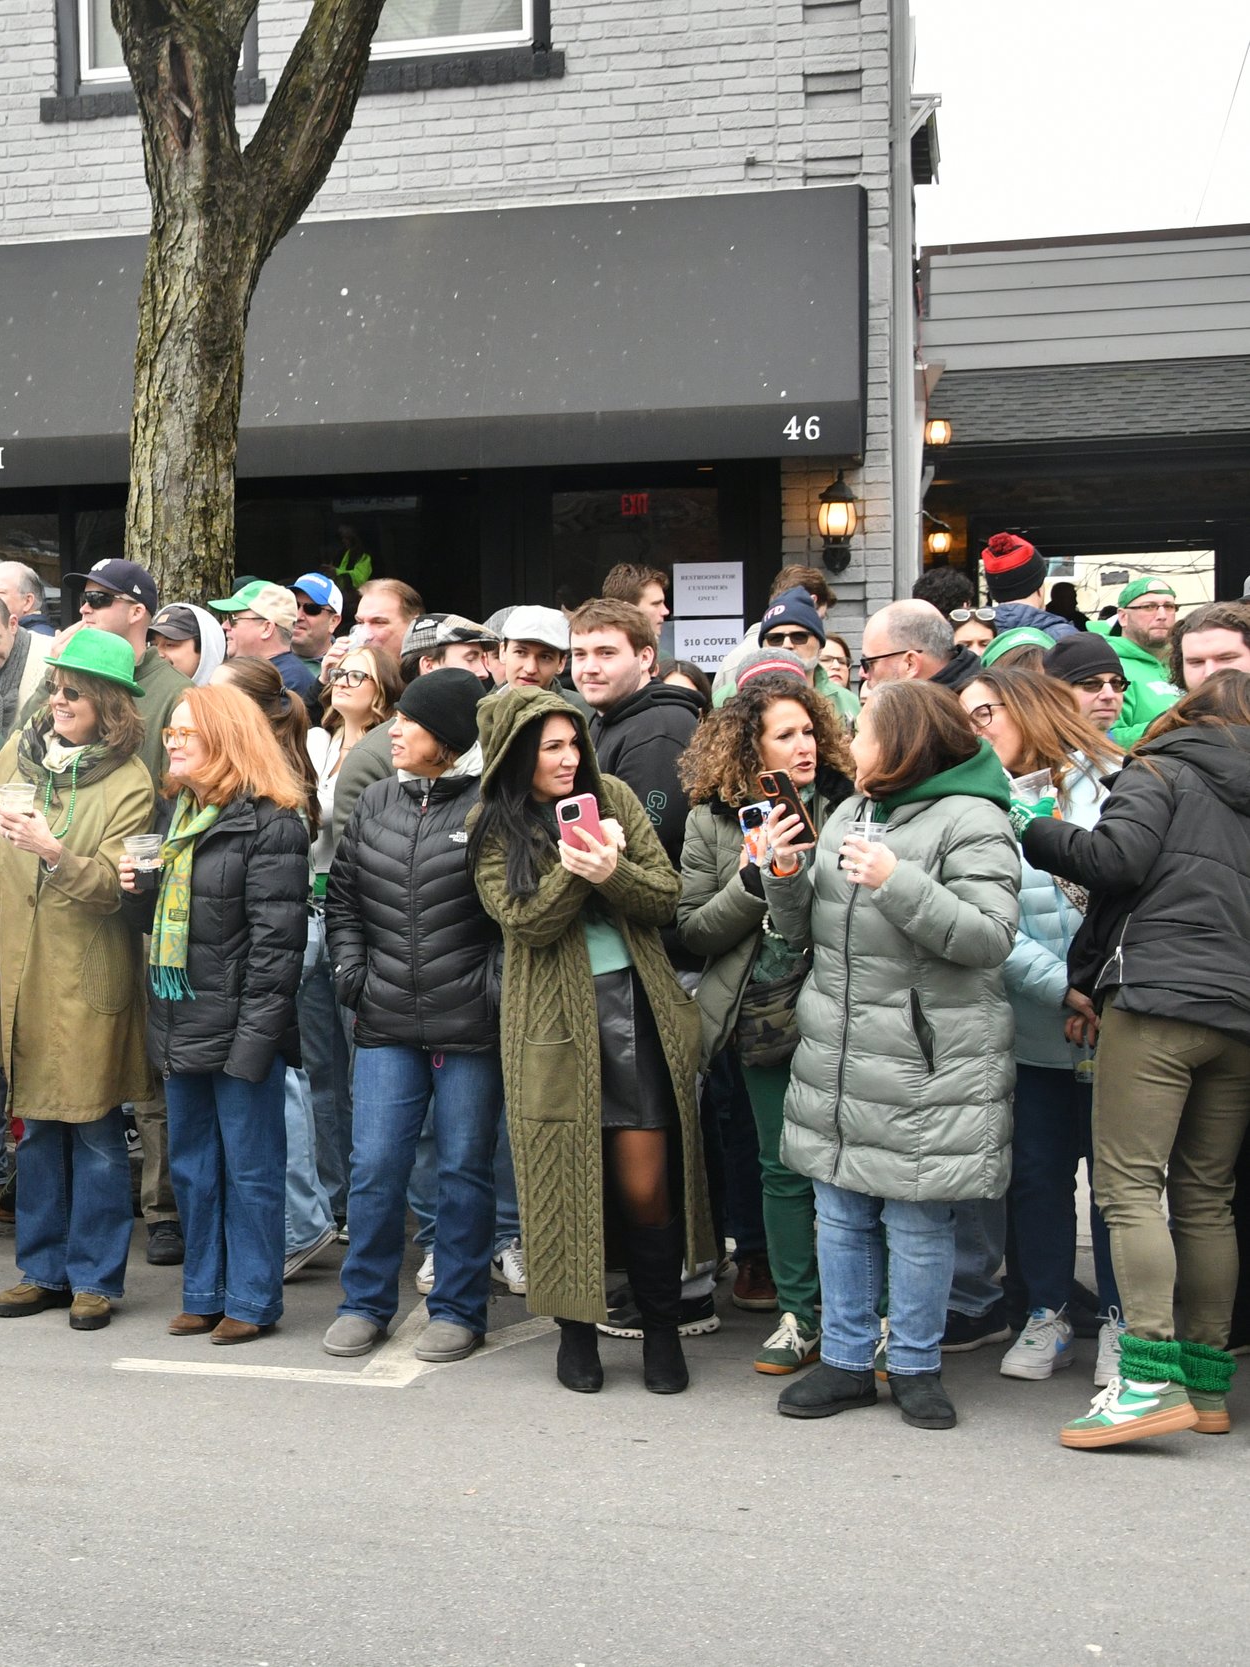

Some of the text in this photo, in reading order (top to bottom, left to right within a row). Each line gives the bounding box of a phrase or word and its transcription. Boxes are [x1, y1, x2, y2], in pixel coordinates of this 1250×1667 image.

[783, 415, 821, 440] 46
[621, 493, 649, 515] EXIT
[684, 637, 737, 647] $10 COVER
